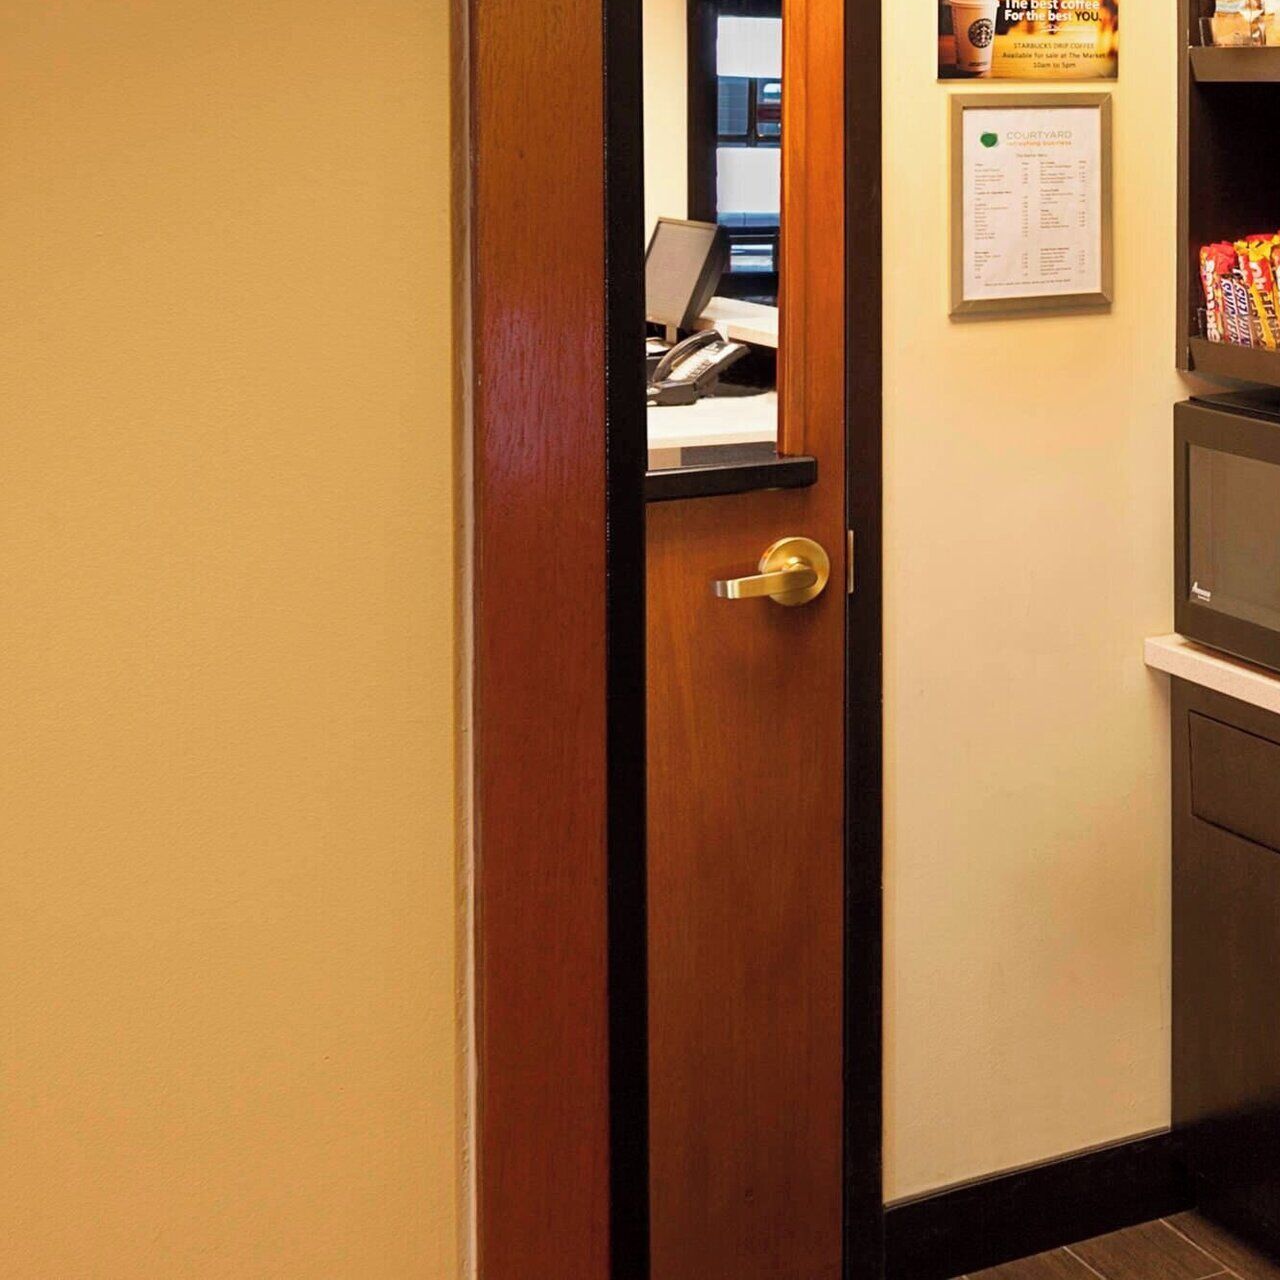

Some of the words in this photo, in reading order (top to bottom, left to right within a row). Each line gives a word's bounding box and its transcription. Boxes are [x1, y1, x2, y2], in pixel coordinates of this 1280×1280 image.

[1004, 9, 1025, 21] For
[1026, 10, 1046, 21] the
[1047, 10, 1072, 21] best
[1074, 11, 1102, 22] YOU.
[1002, 51, 1032, 59] Available
[1033, 51, 1043, 59] for
[1006, 130, 1073, 140] COURTYARD
